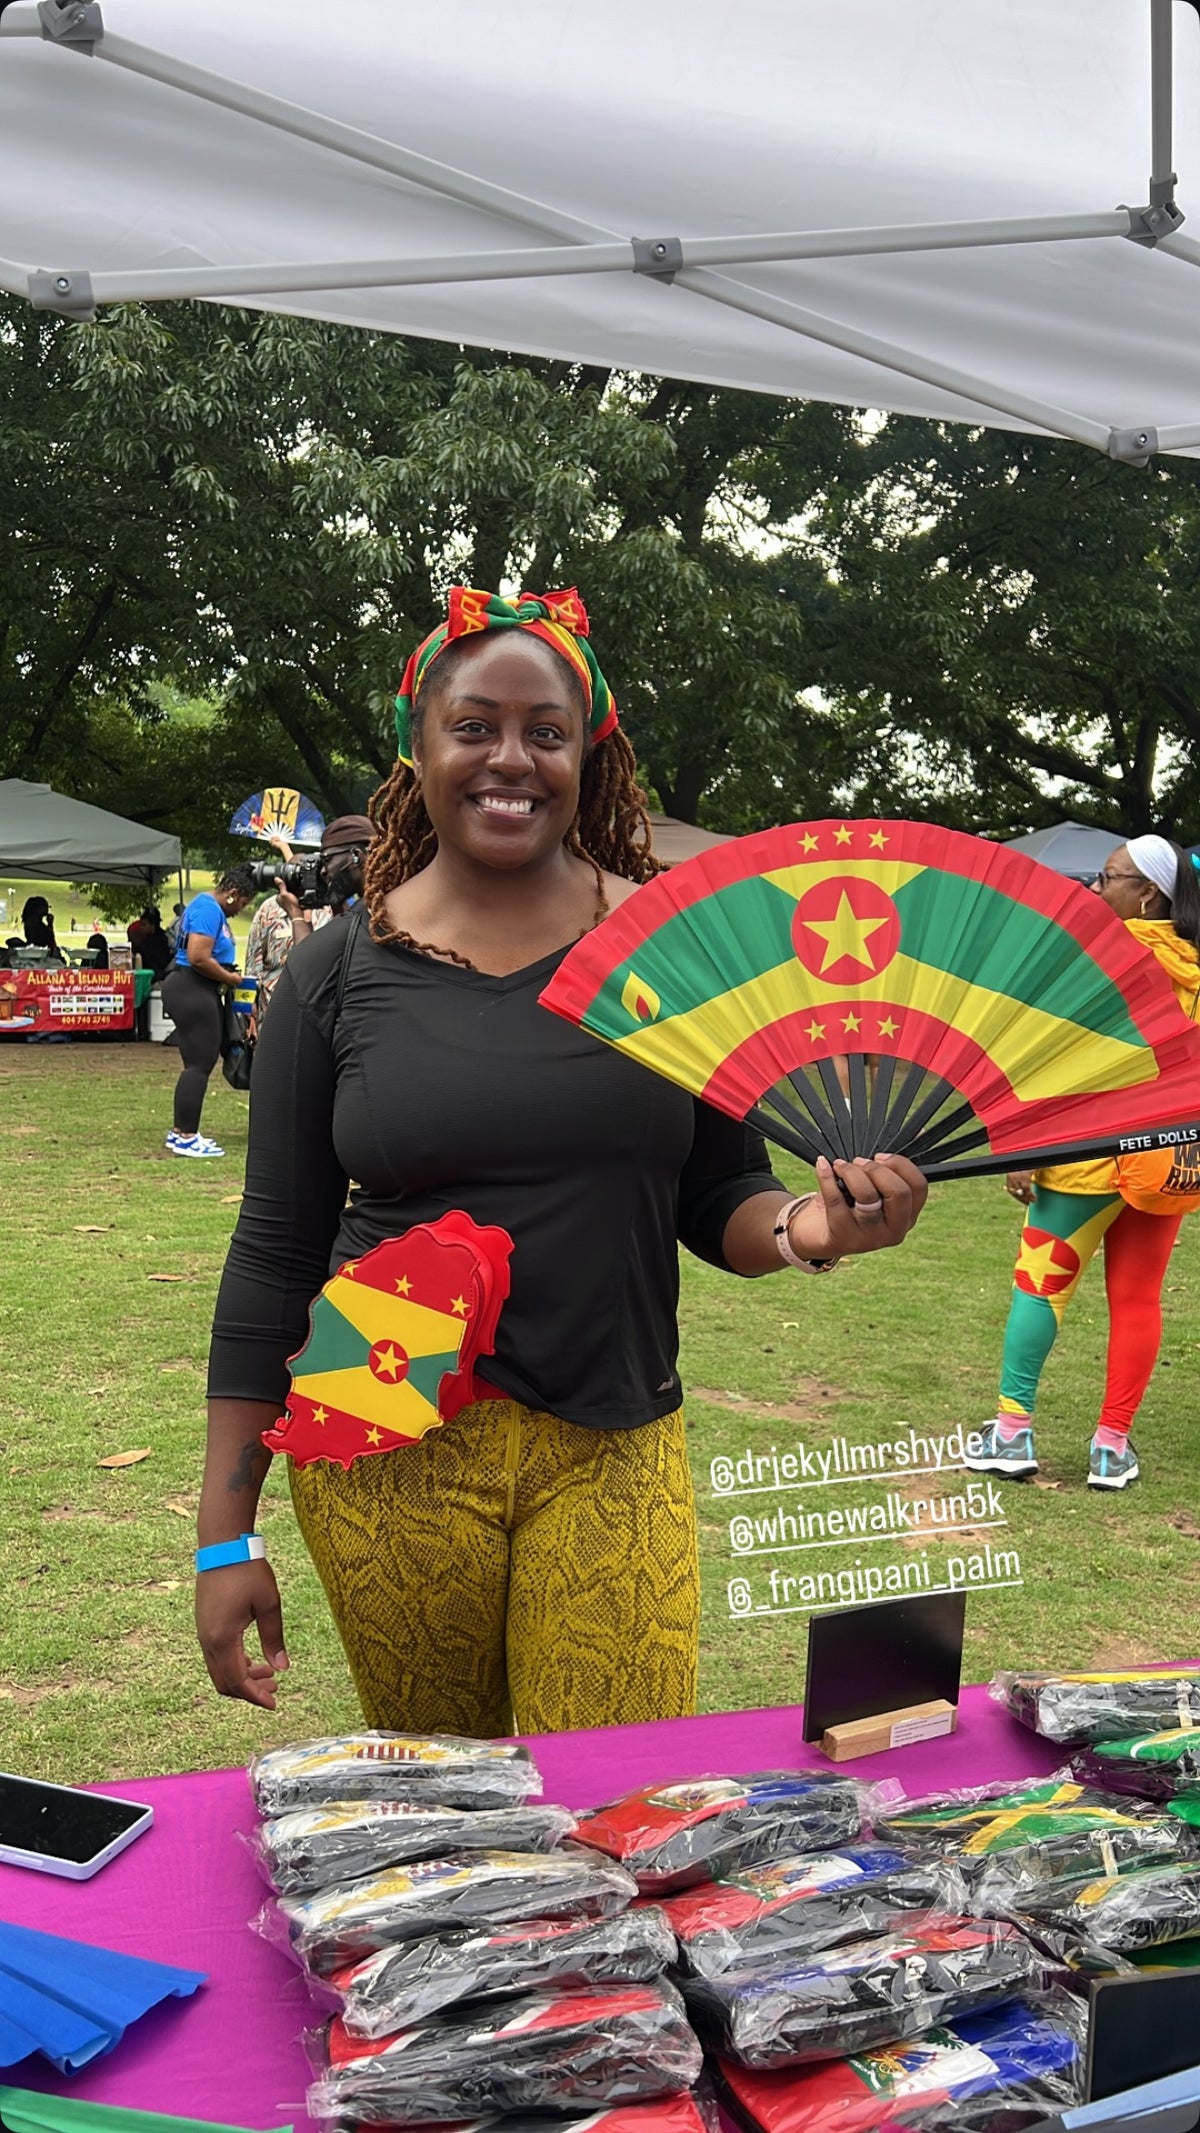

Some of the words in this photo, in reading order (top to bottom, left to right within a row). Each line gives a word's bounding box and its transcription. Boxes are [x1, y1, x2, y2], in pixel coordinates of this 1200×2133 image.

[78, 971, 110, 984] ISLAND
[113, 970, 132, 984] HUT
[61, 1016, 75, 1024] 404
[1119, 1135, 1152, 1151] FETE
[1158, 1129, 1198, 1145] DOLLS
